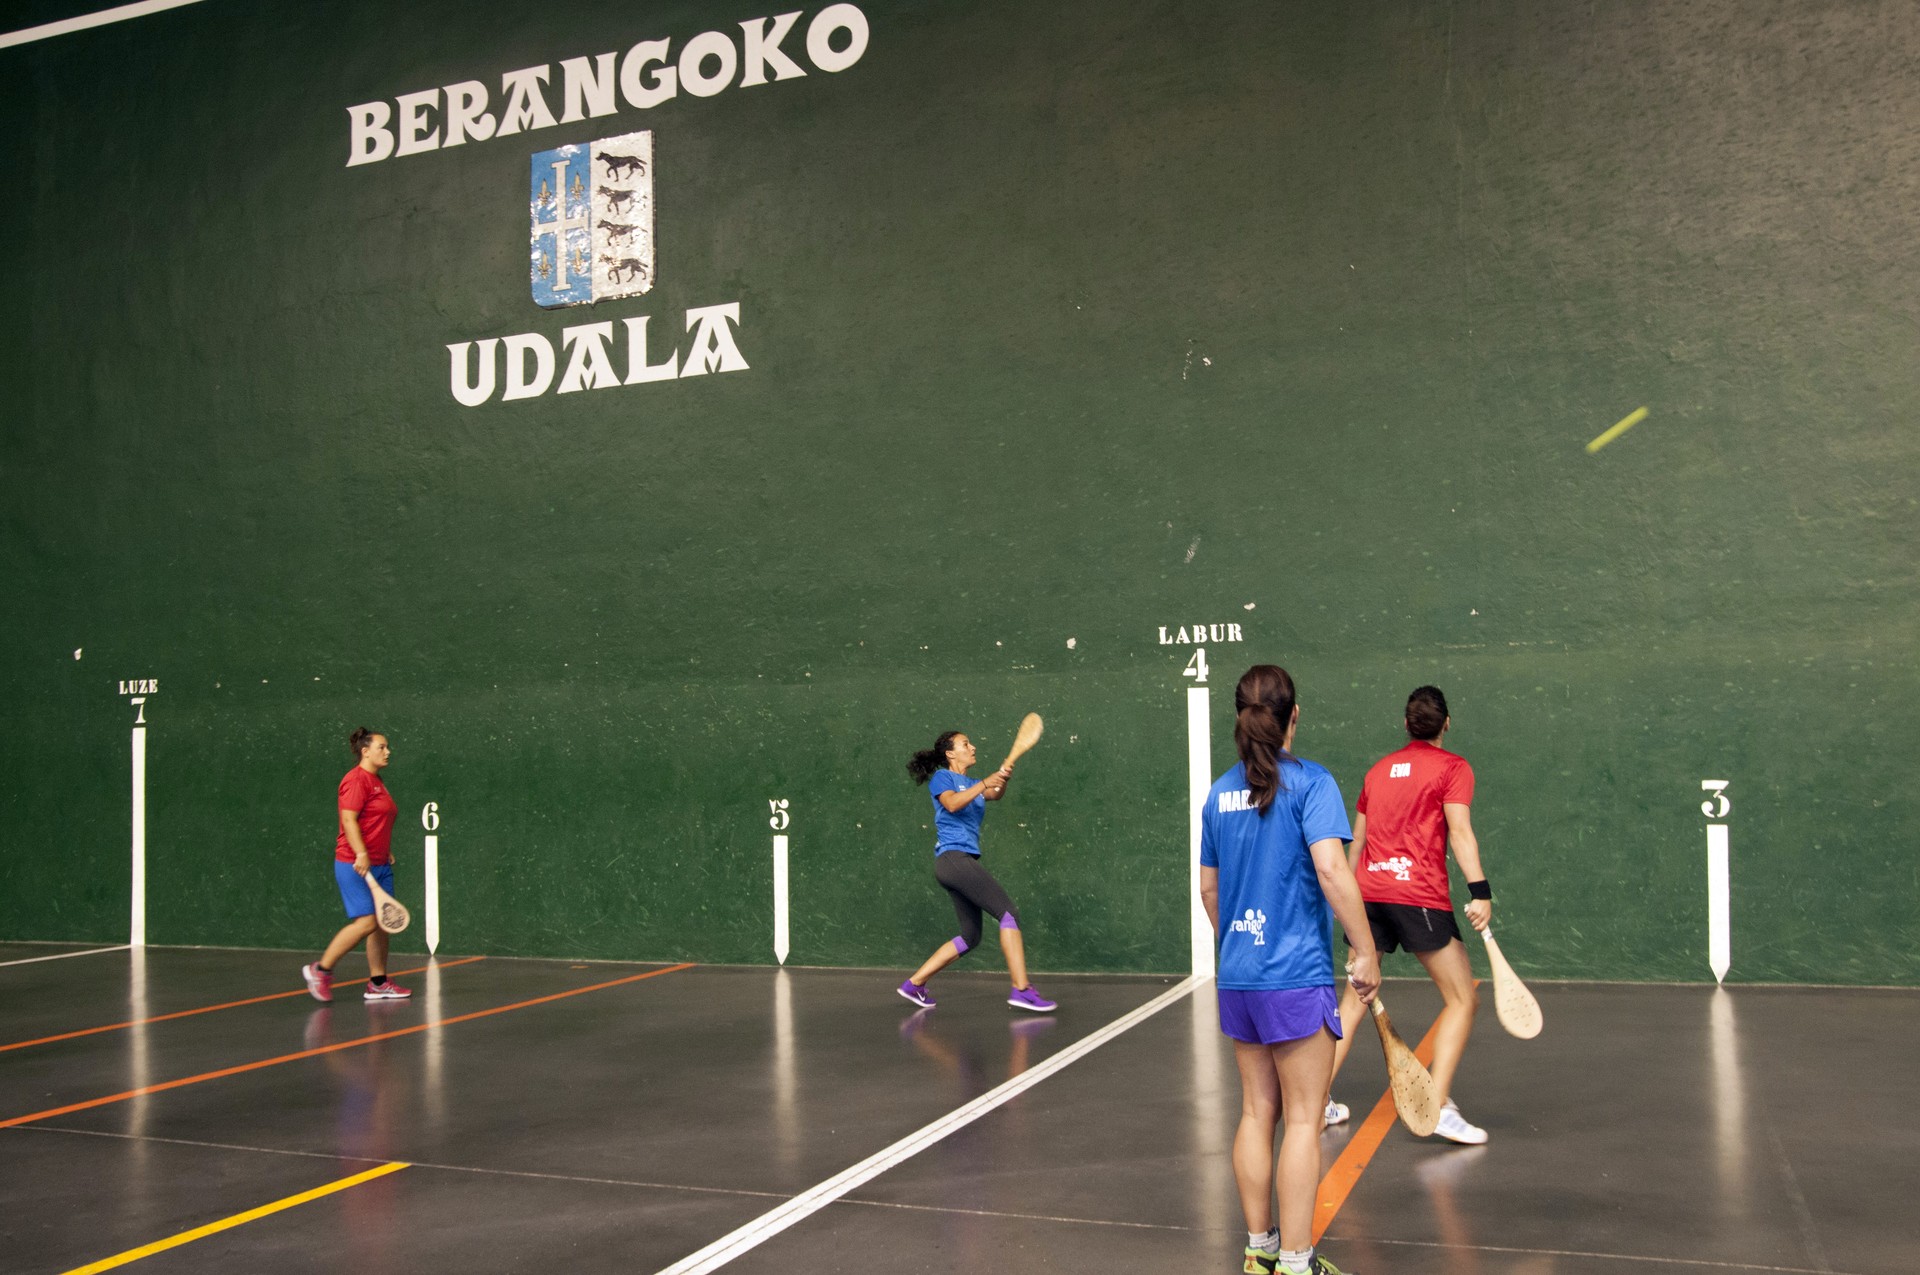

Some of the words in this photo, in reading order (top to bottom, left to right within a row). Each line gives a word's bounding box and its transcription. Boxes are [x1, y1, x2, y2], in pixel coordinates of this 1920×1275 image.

[345, 3, 870, 168] BERANGOKO
[445, 301, 751, 408] UDALA
[1158, 623, 1243, 645] LABUR
[1182, 647, 1210, 683] 4
[119, 678, 158, 695] LUZE
[130, 697, 147, 724] 7
[1389, 762, 1411, 778] EVA
[1701, 779, 1731, 818] 3
[421, 801, 440, 831] 6
[768, 798, 790, 831] 5
[1394, 870, 1411, 881] 21
[1253, 930, 1266, 946] 21
